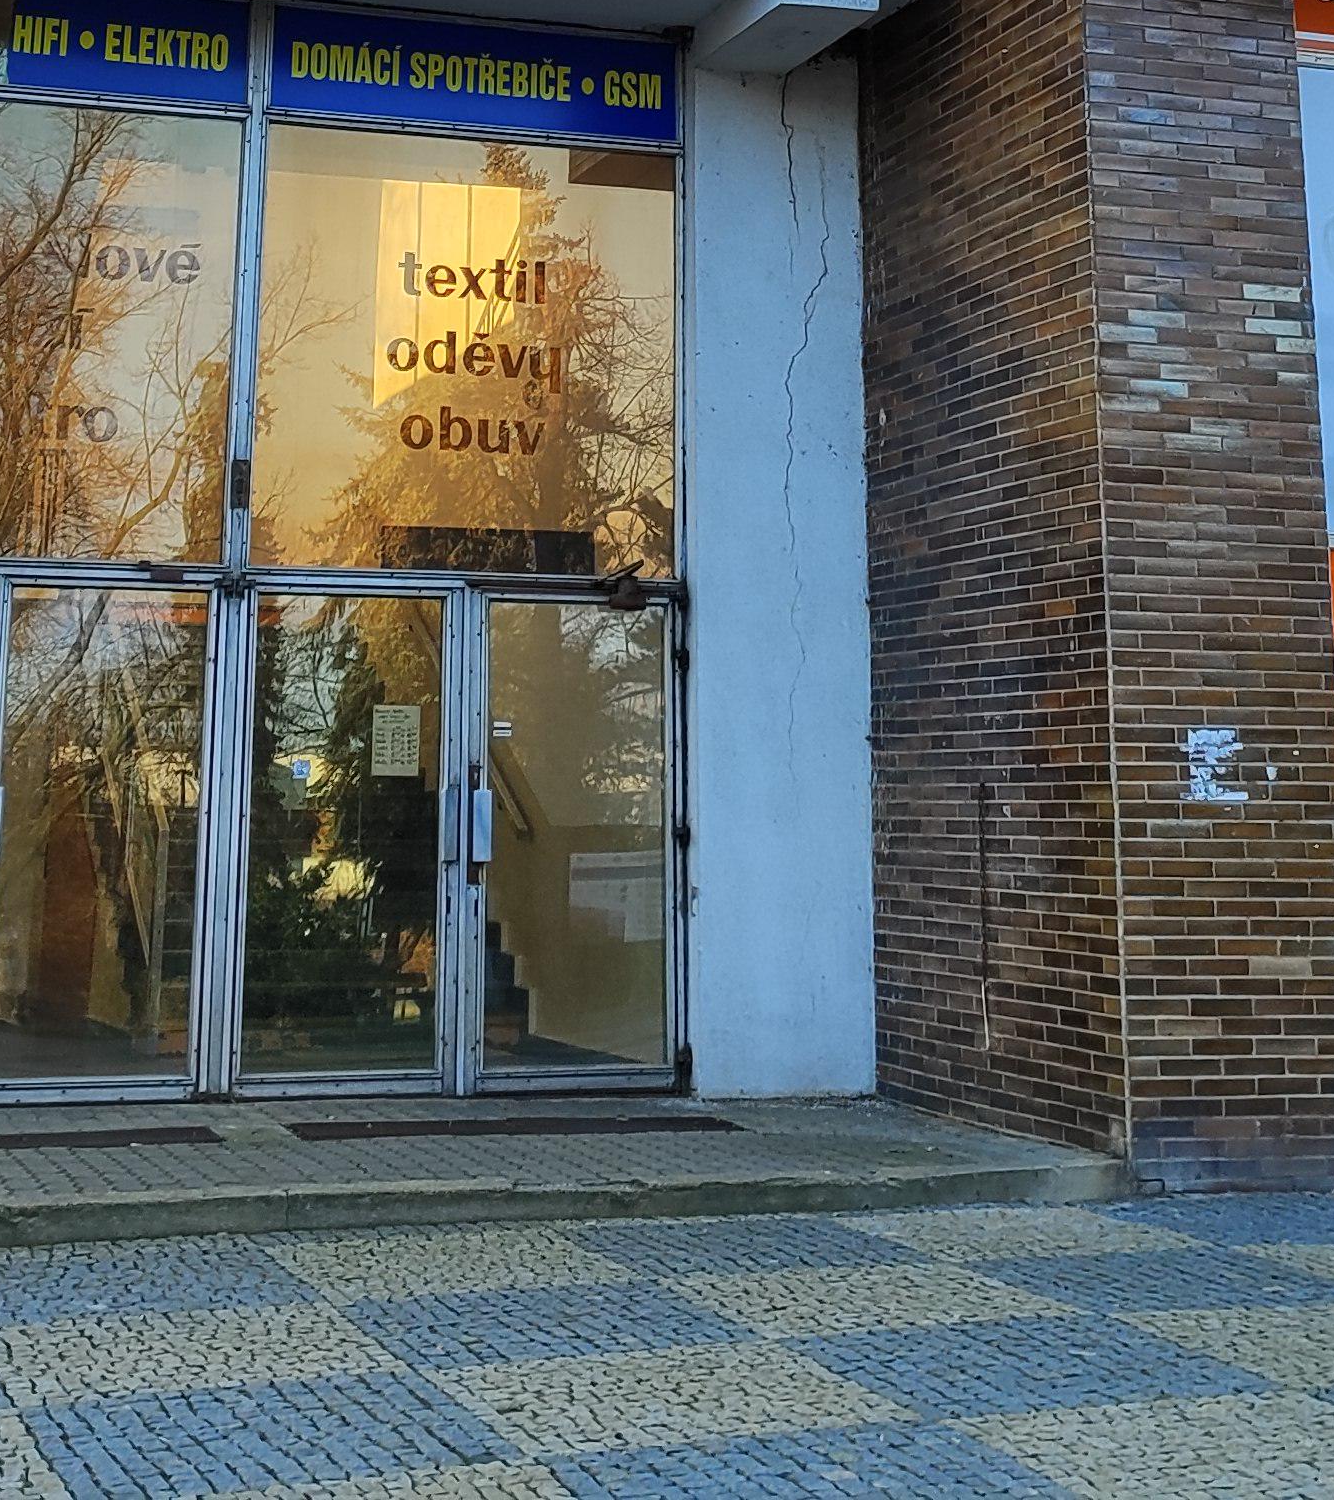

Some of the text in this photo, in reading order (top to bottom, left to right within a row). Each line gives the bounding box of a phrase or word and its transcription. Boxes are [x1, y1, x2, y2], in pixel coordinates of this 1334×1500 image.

[12, 14, 69, 58] HIFI
[104, 23, 230, 72] ELEKTRO
[290, 41, 662, 110] DOMÁCÍ SPOTŘEBIČE GSM
[397, 251, 546, 305] textil
[386, 331, 562, 394] oděvy
[399, 406, 546, 456] obuv
